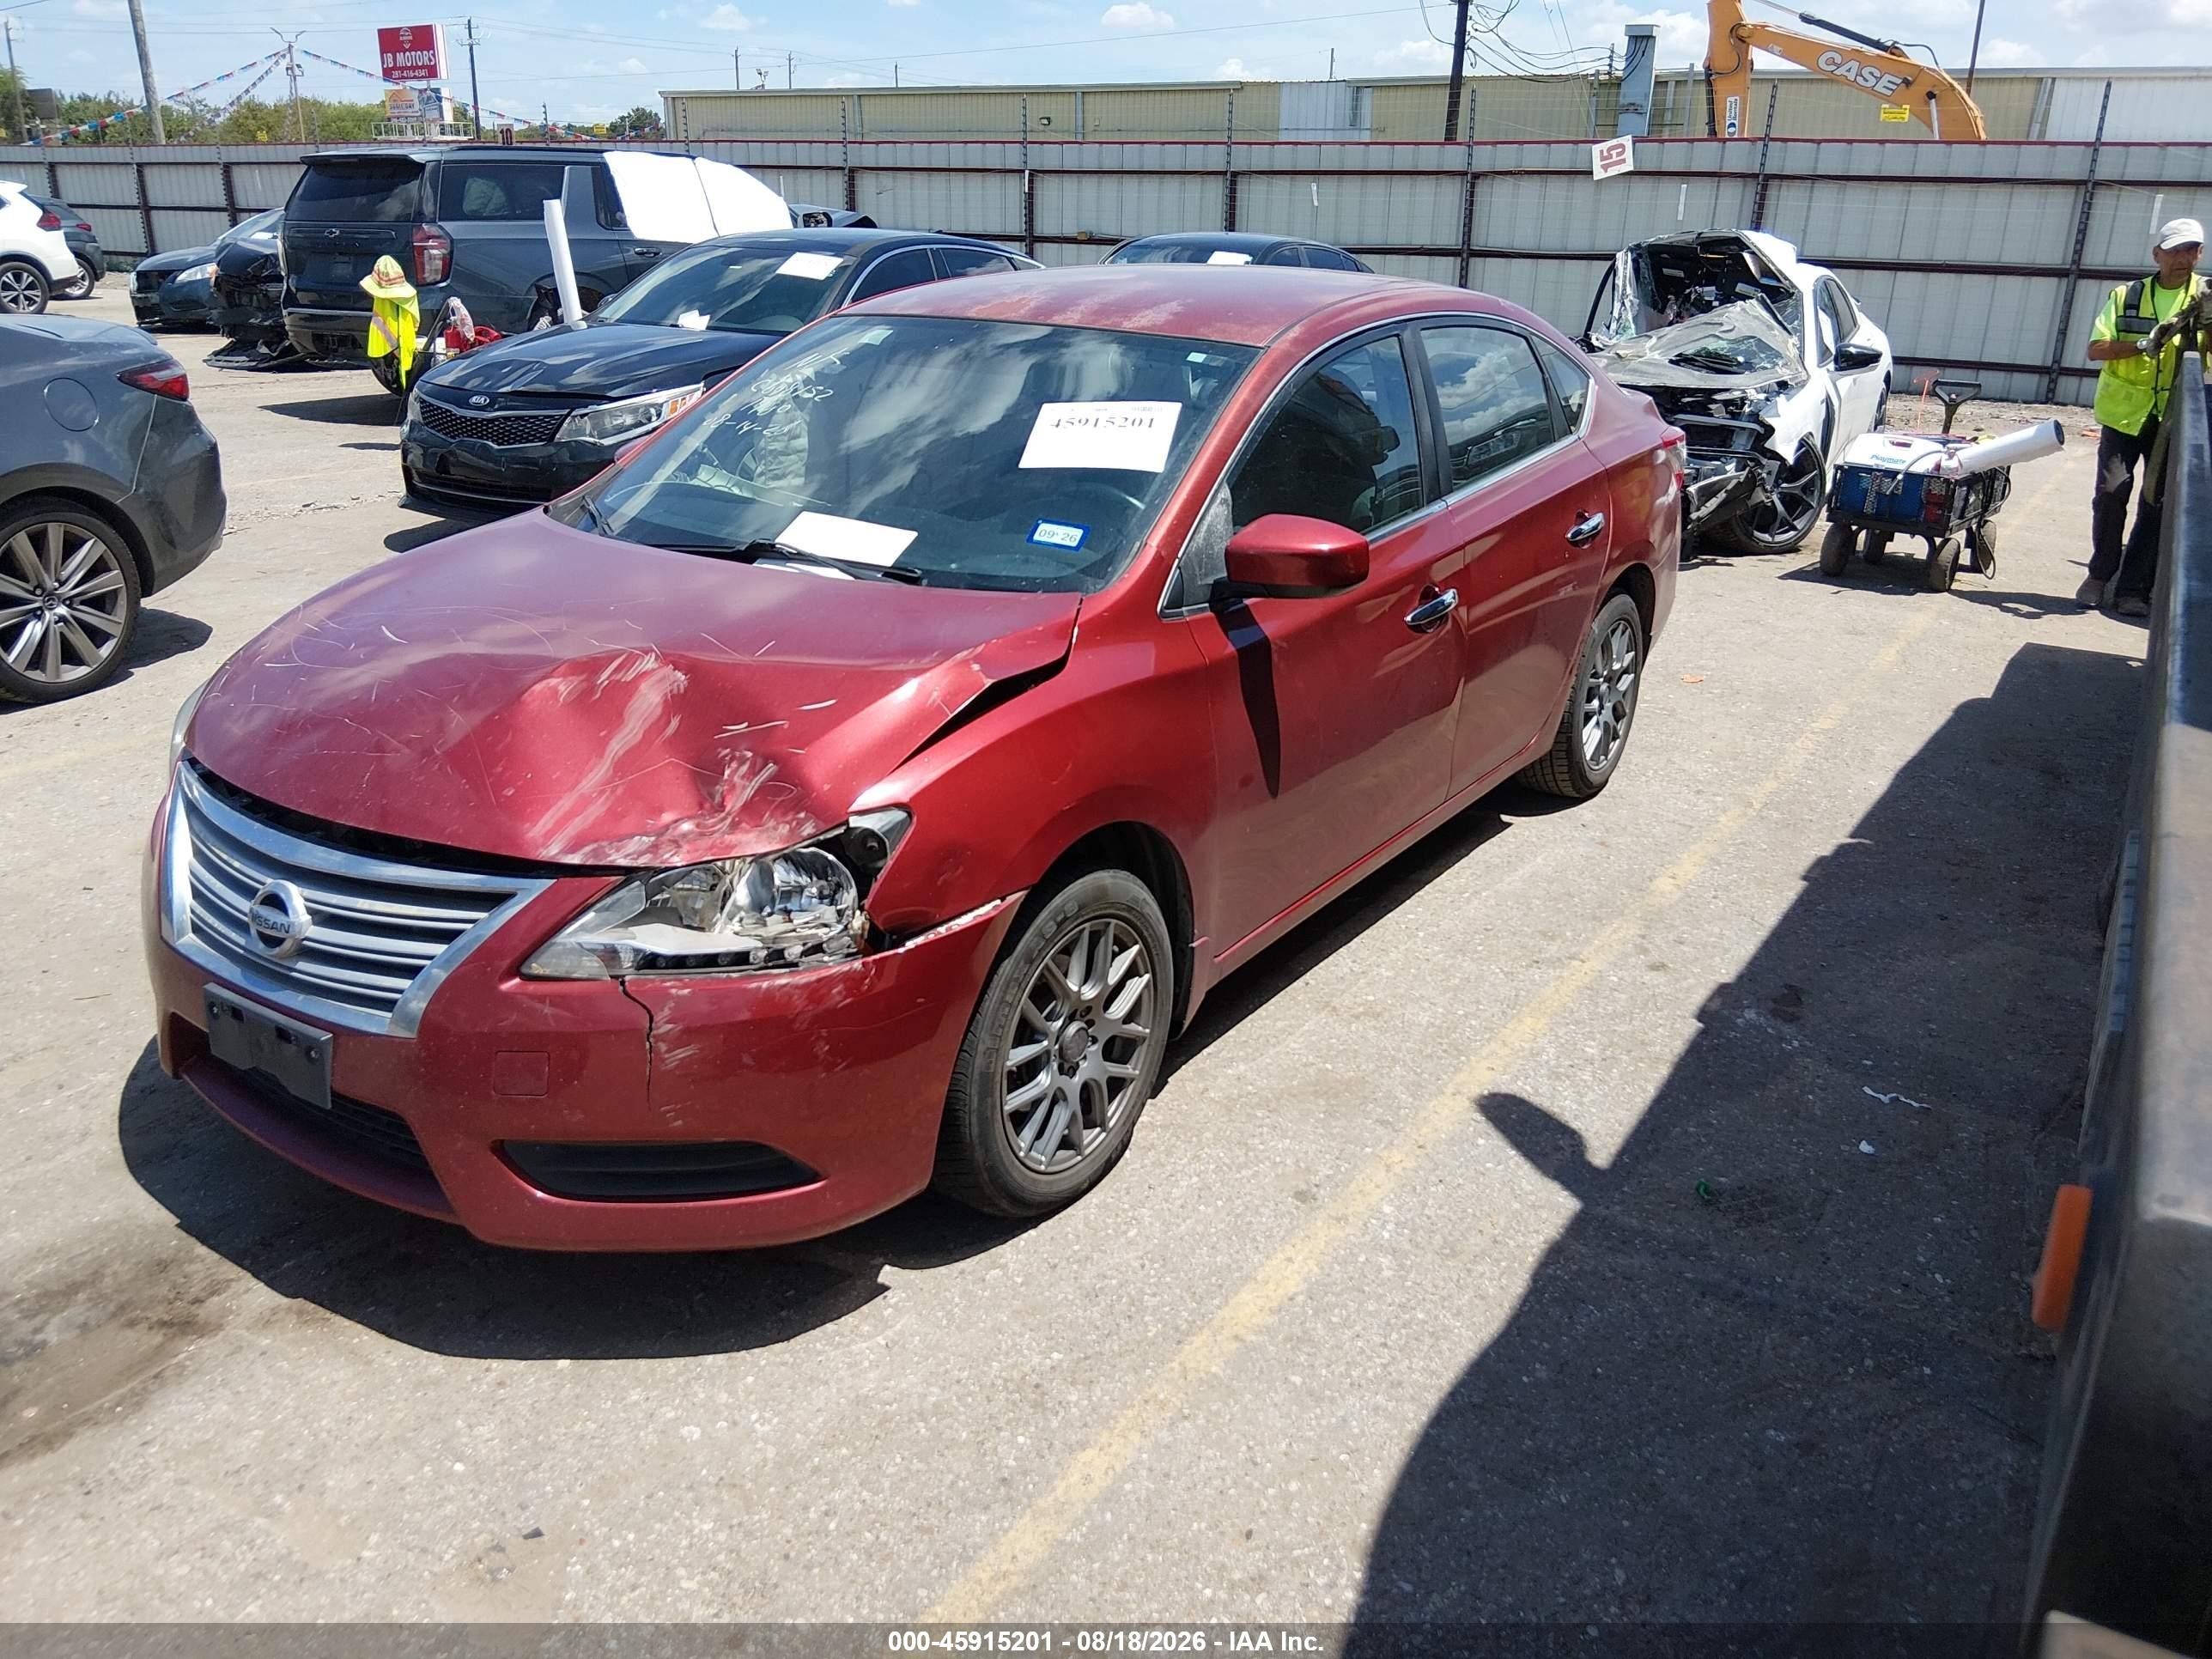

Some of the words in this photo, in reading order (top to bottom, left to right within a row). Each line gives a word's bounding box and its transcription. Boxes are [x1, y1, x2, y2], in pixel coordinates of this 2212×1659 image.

[383, 52, 394, 69] JB
[396, 50, 435, 67] MOTORS
[1816, 50, 1904, 97] CASE
[499, 127, 514, 146] 10
[1599, 143, 1626, 173] 15
[471, 394, 485, 404] KIA
[1050, 416, 1155, 429] 45915201
[1870, 453, 1907, 465] Playmate
[251, 912, 290, 934] NISSAN
